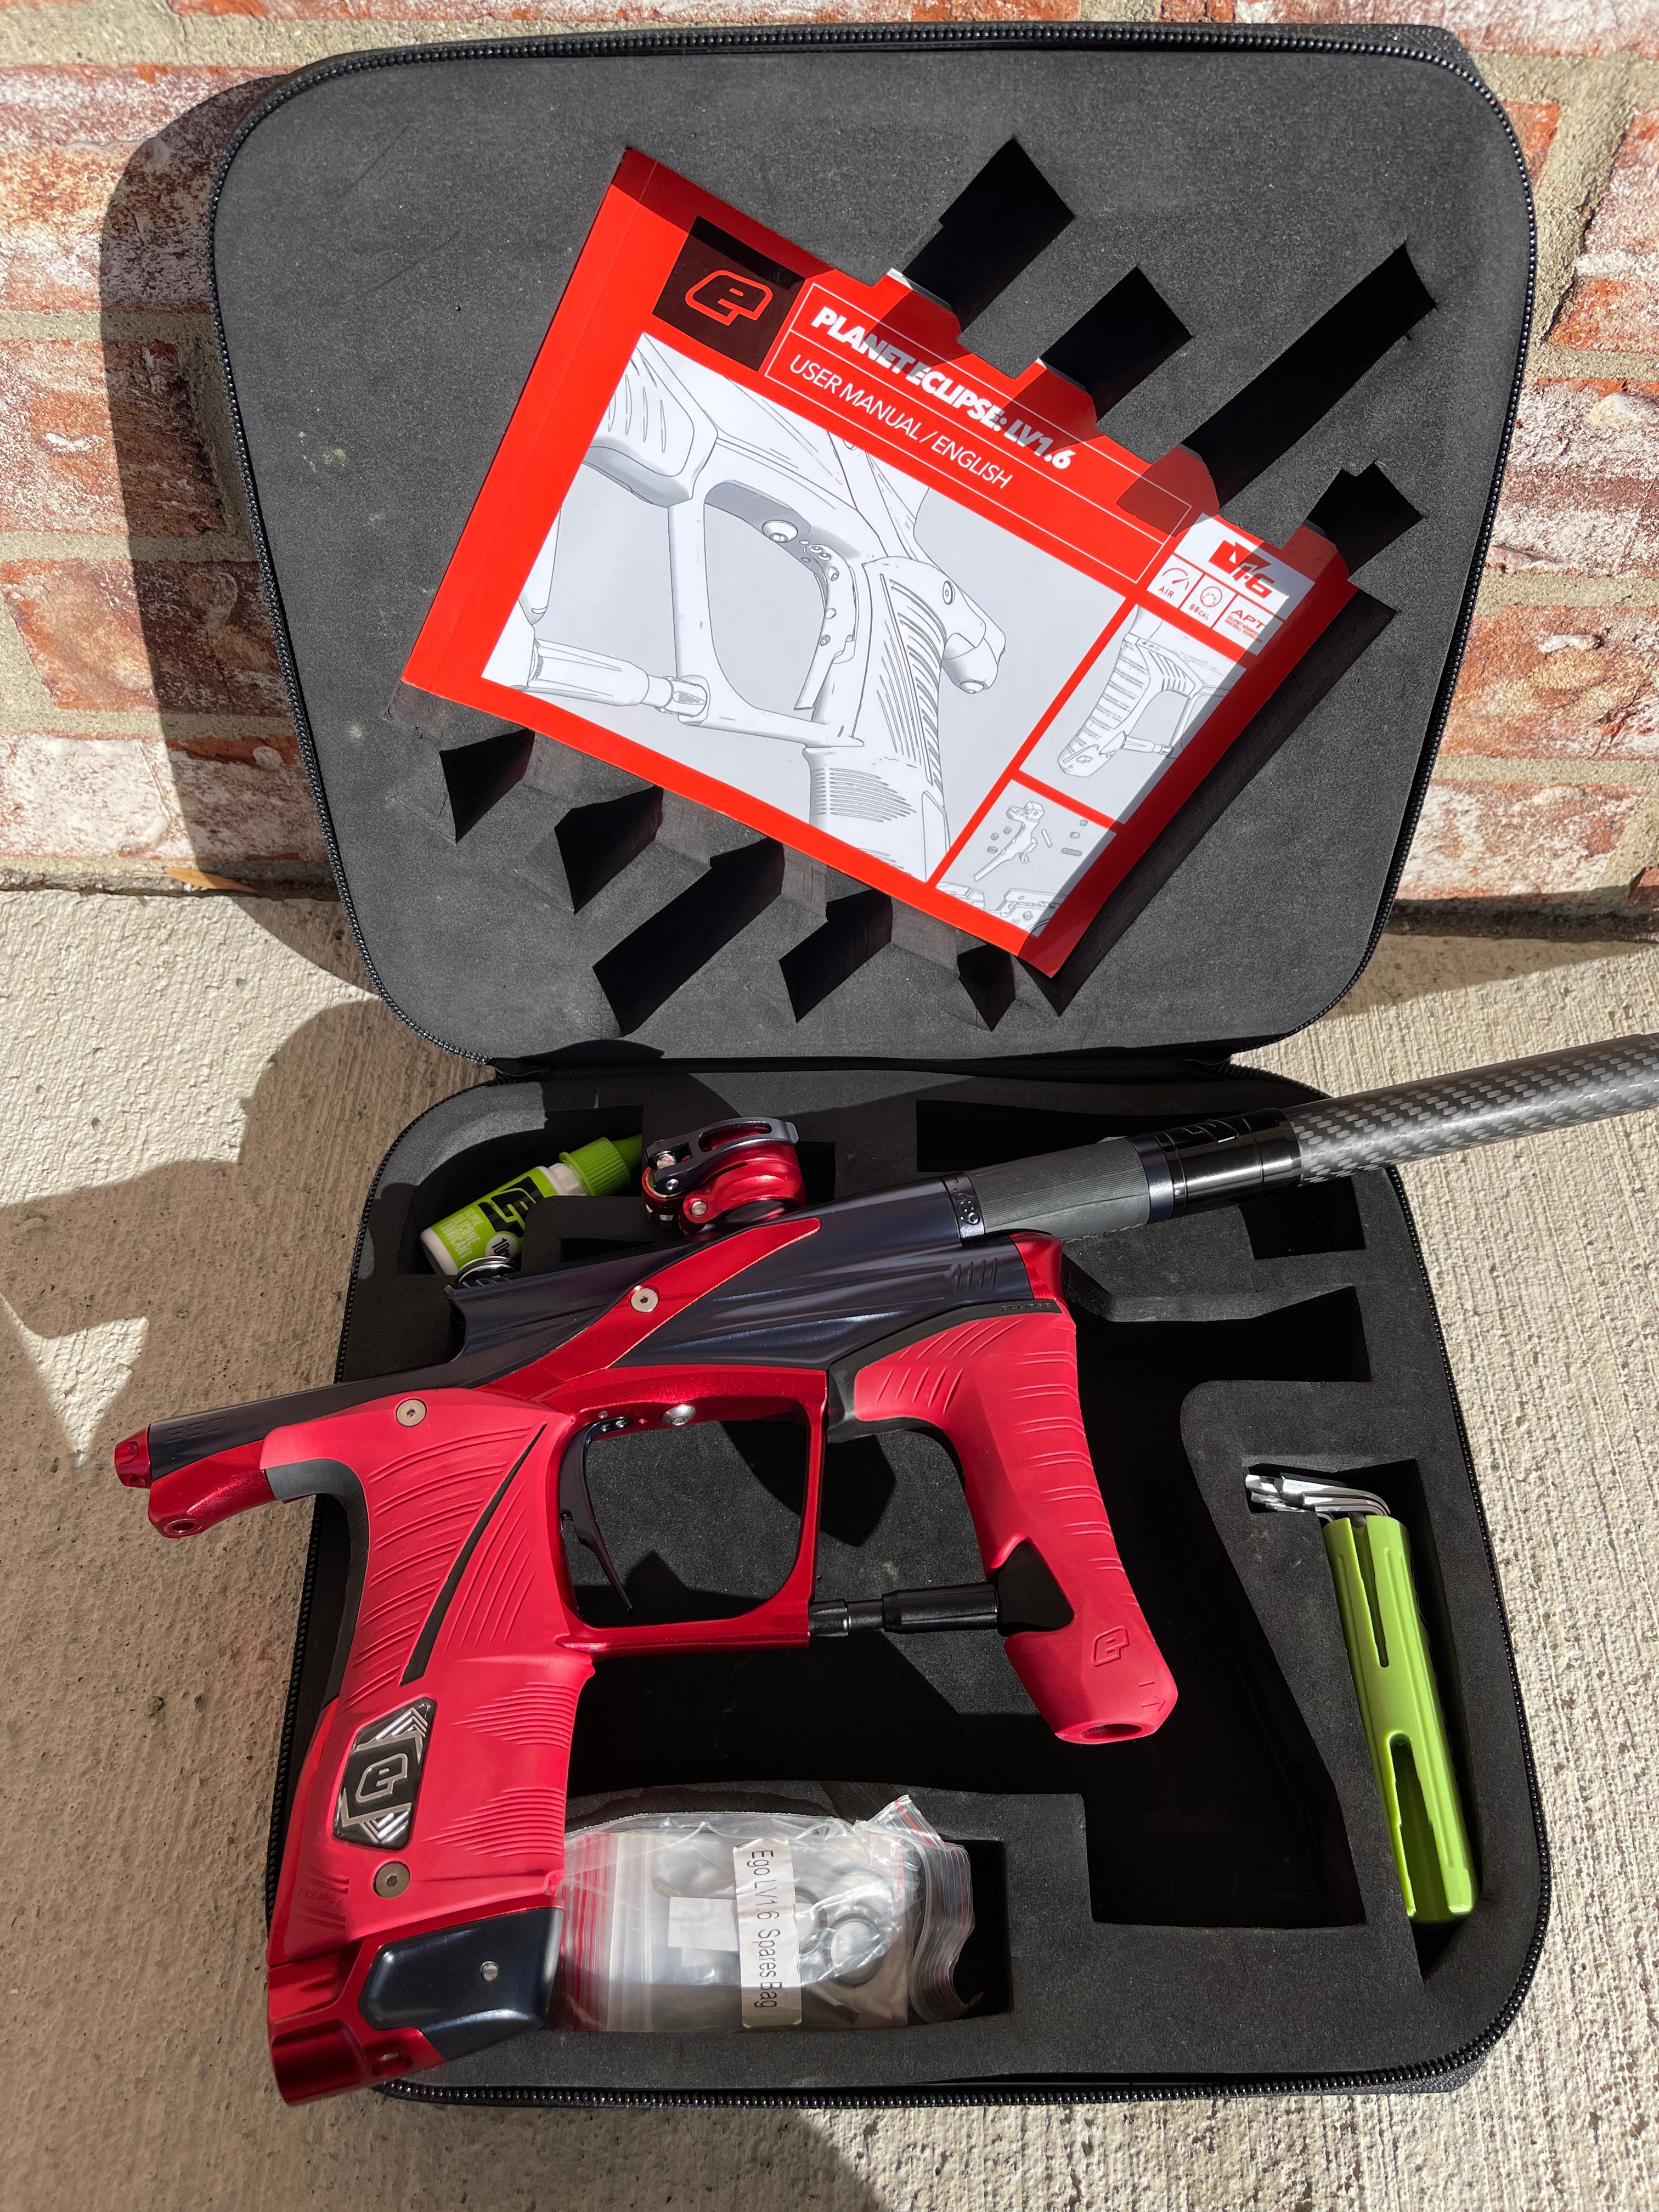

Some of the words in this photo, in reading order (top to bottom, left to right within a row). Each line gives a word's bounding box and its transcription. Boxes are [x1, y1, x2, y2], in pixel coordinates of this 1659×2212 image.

[811, 307, 916, 374] PLANET
[905, 362, 1007, 431] ECLIPSE:
[1003, 419, 1076, 469] LV1.6
[790, 354, 842, 394] USER
[839, 383, 922, 440] MANUAL
[919, 431, 938, 443] /
[931, 435, 1013, 489] ENGLISH
[1158, 585, 1175, 599] AIR
[1230, 610, 1267, 629] APT
[439, 1221, 473, 1260] LUBRICANT
[451, 1213, 482, 1247] SILICONE
[747, 1850, 774, 1875] Ego
[754, 1880, 780, 1920] LV1.6
[752, 1928, 781, 1978] Spares
[754, 1982, 782, 2008] Bag
